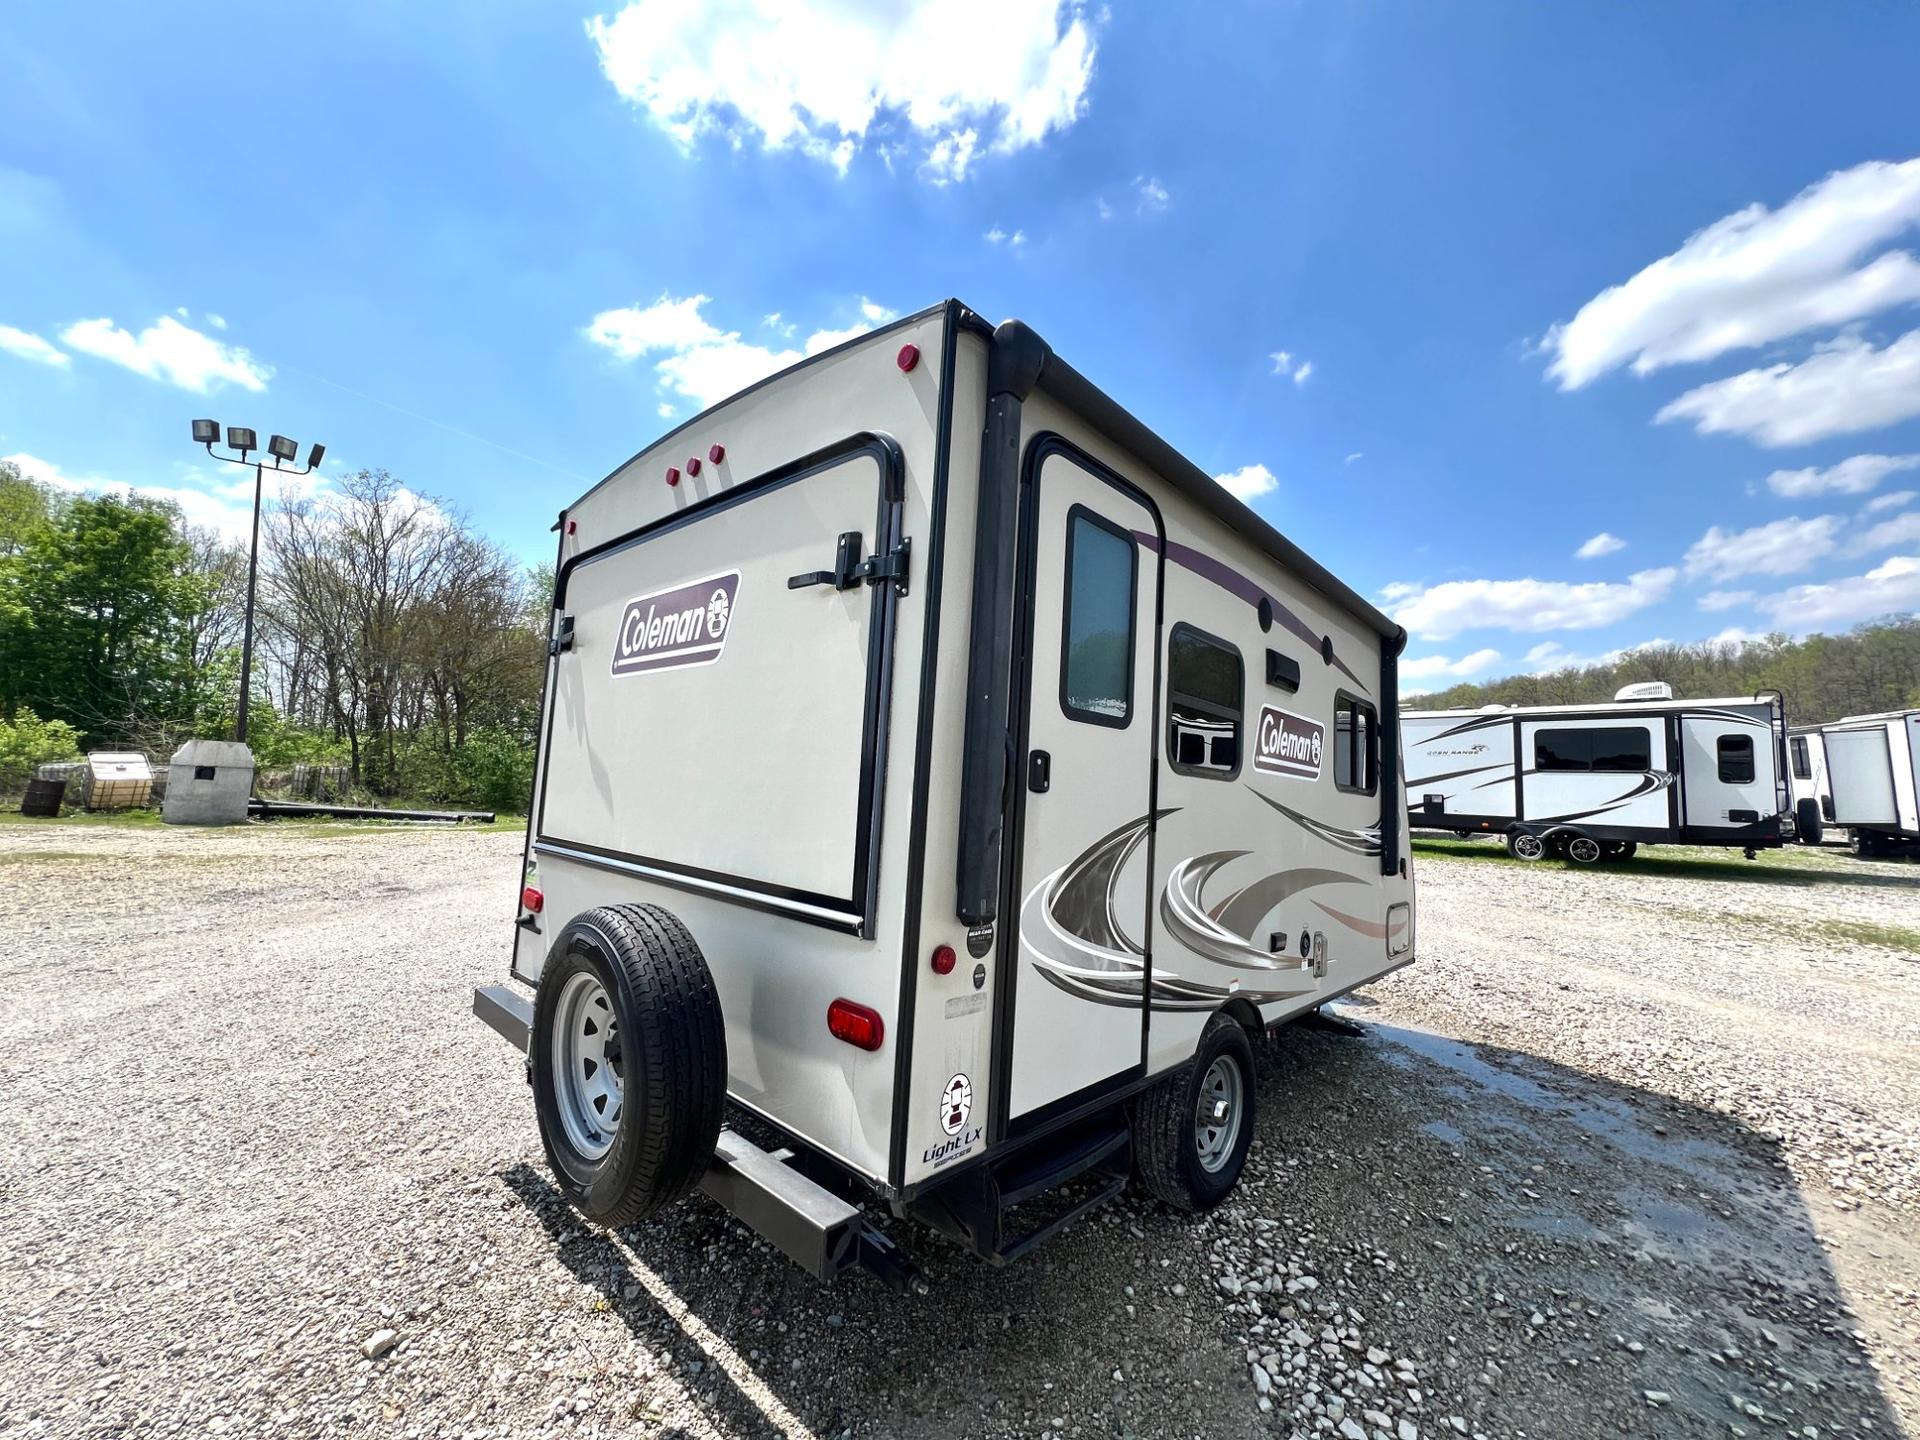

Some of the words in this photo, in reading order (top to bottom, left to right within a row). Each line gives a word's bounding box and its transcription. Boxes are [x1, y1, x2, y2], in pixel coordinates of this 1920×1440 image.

[622, 604, 706, 657] Coleman
[1261, 713, 1311, 762] Coleman
[922, 1136, 962, 1164] Light
[964, 1126, 983, 1145] LX
